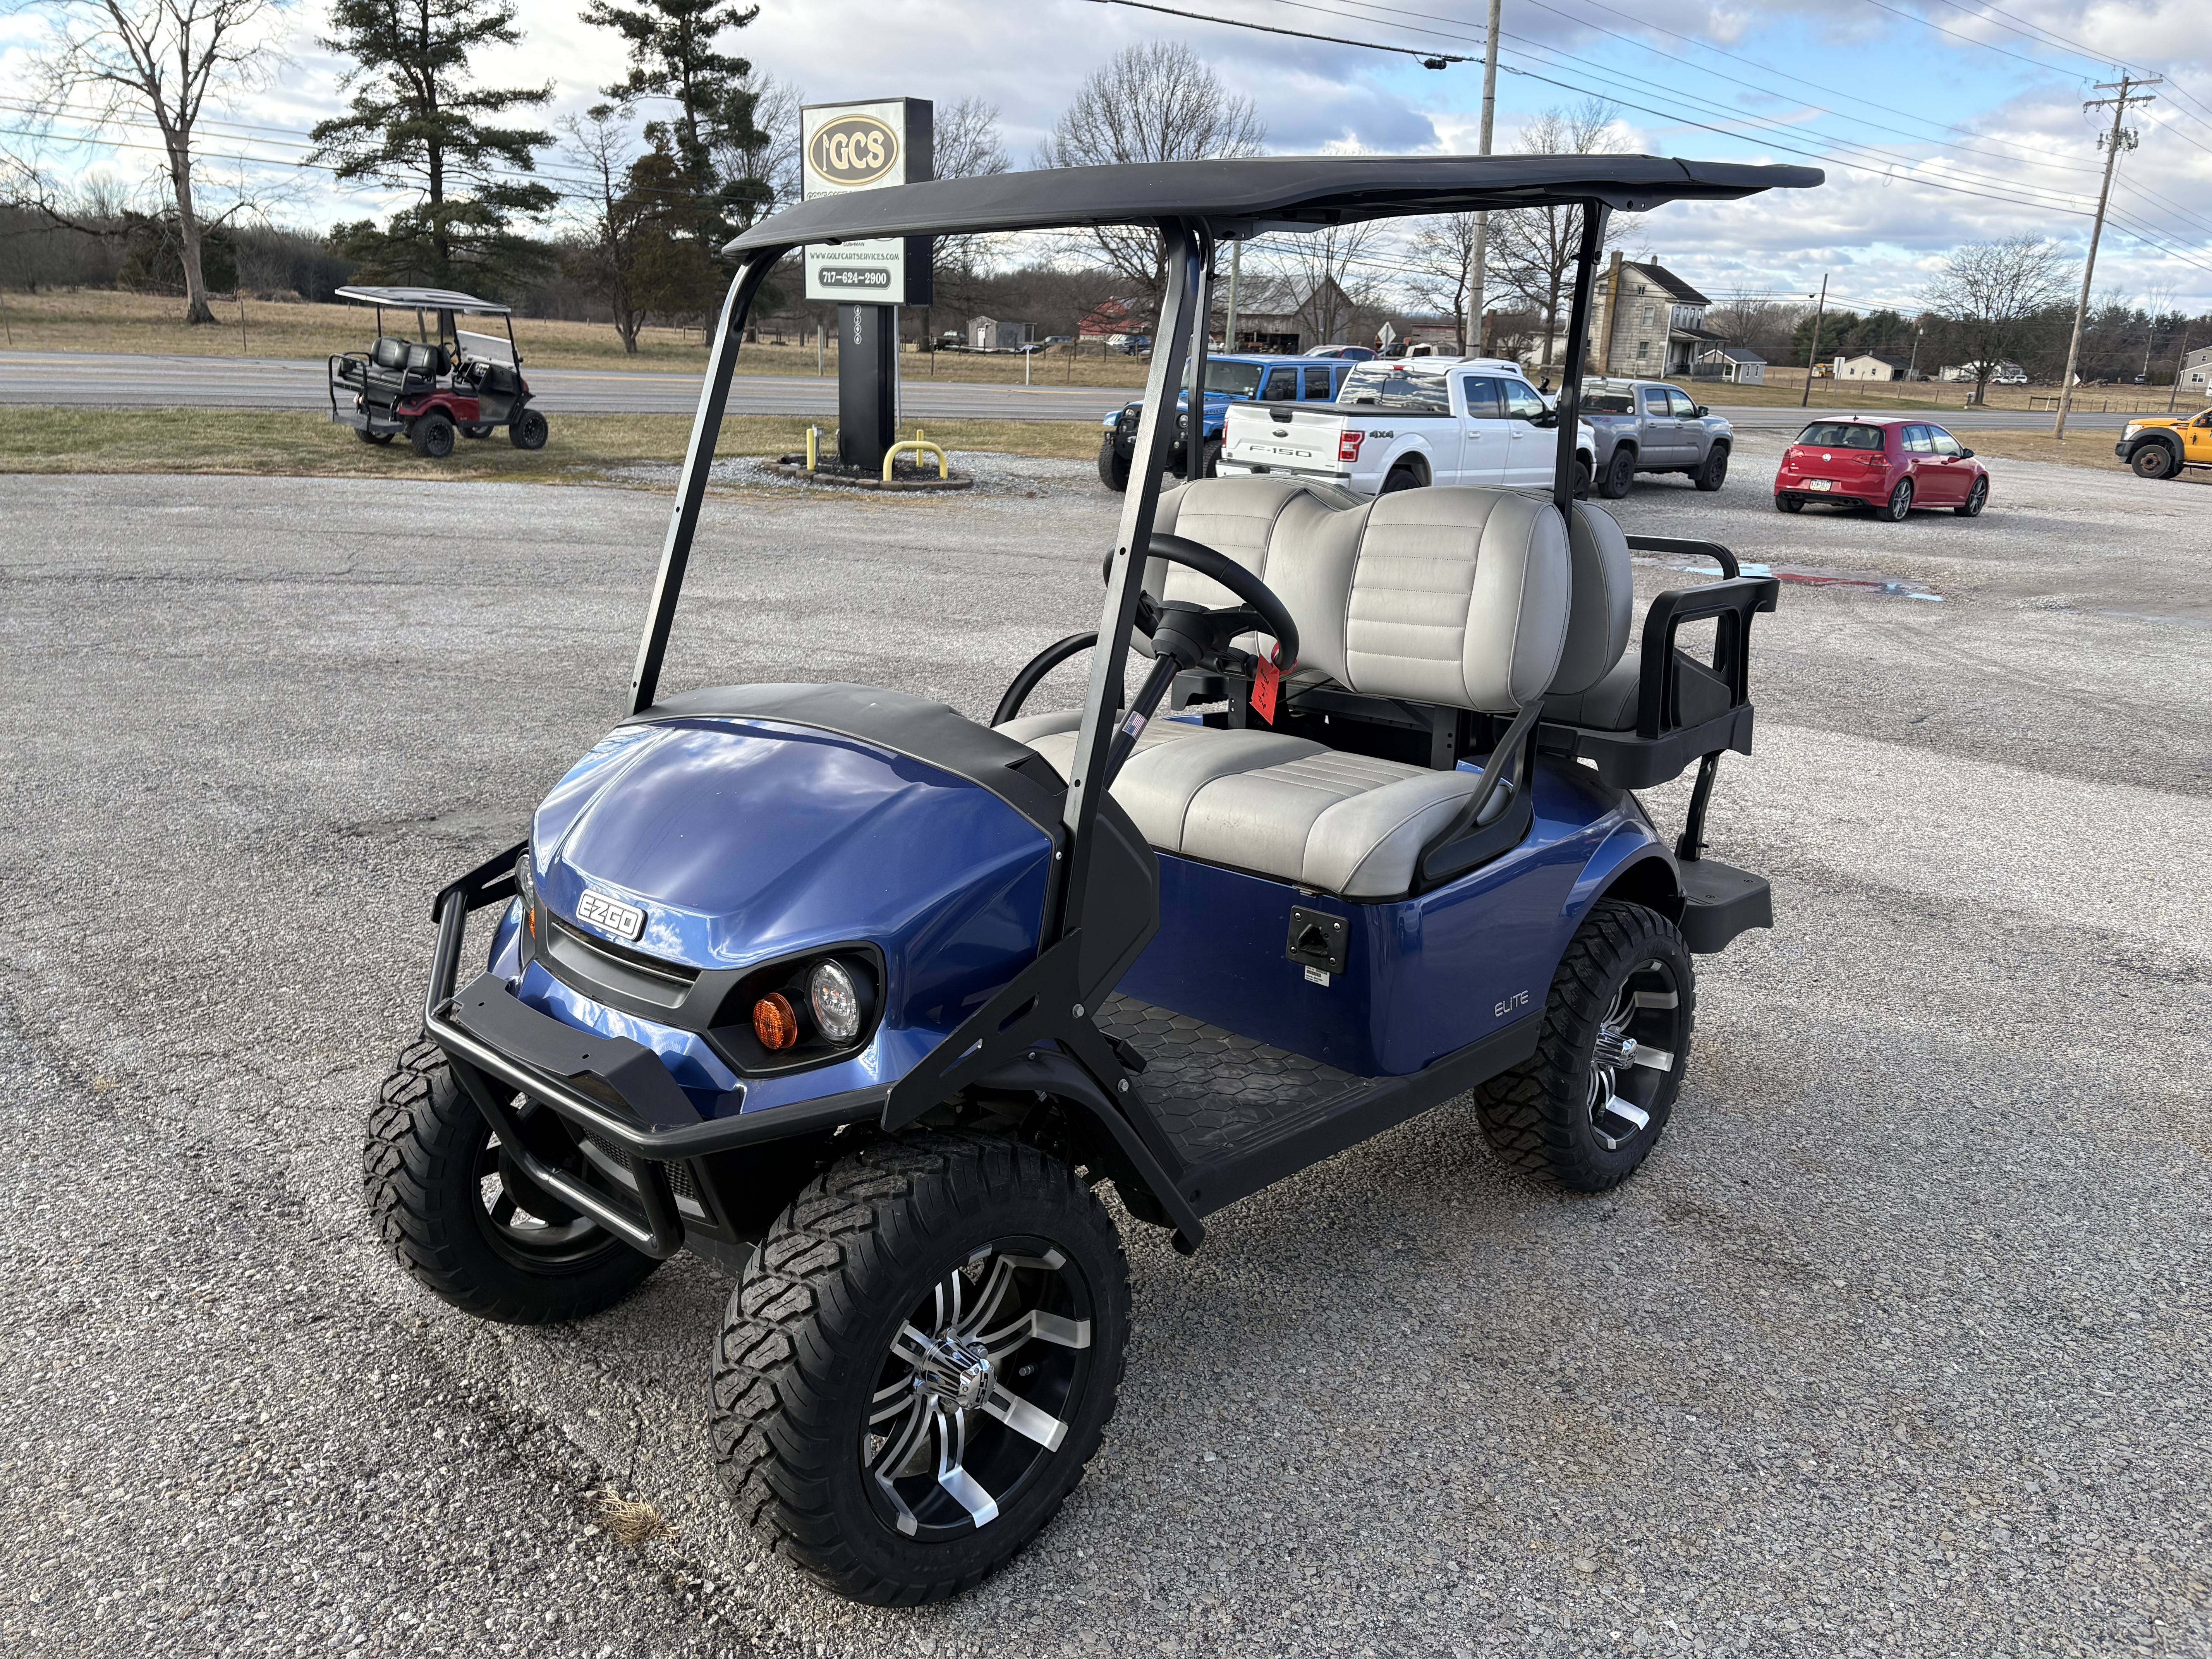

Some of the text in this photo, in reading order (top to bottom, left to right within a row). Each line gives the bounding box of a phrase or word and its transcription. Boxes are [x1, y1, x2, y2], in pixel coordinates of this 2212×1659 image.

[830, 131, 885, 169] GCS
[810, 252, 899, 261] WWW.GOLFCARTSERVICES.COM
[822, 271, 887, 285] 717-624-2900
[1250, 445, 1312, 458] F-150
